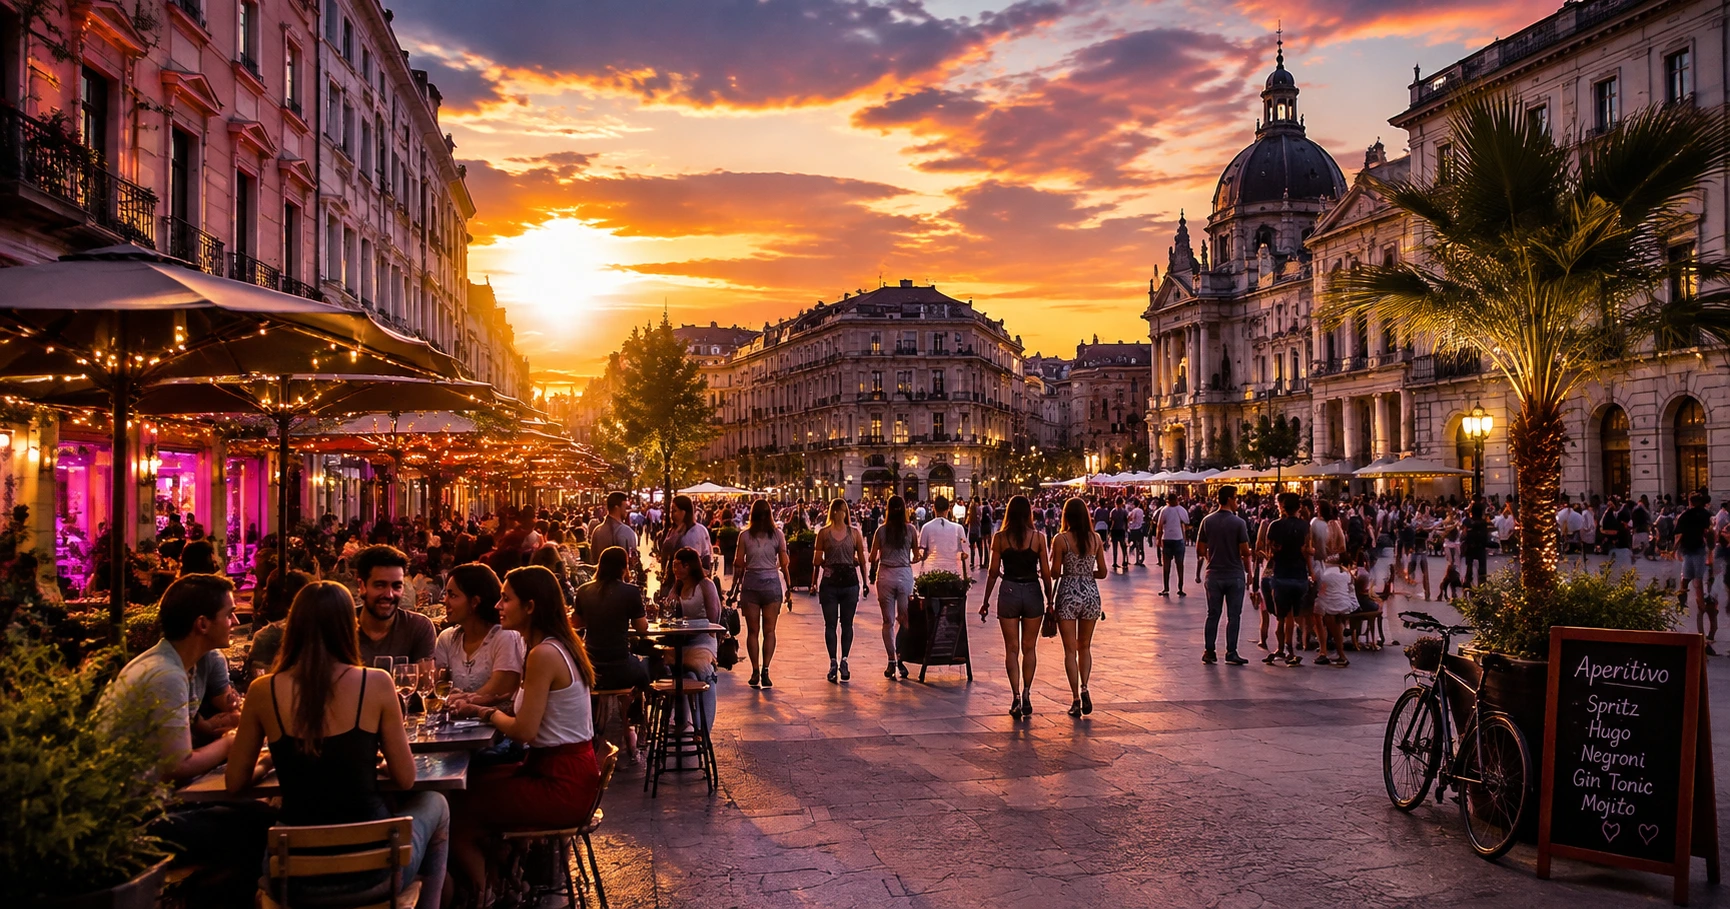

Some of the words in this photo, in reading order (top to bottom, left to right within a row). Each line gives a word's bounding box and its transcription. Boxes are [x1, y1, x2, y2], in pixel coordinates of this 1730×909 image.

[1574, 655, 1669, 686] Aperitivo
[1586, 694, 1640, 721] Spritz
[1588, 719, 1631, 748] Hugo
[1581, 744, 1645, 772] Negroni
[1573, 768, 1601, 788] Gin
[1609, 772, 1653, 795] Tonic
[1581, 794, 1635, 819] Mojito
